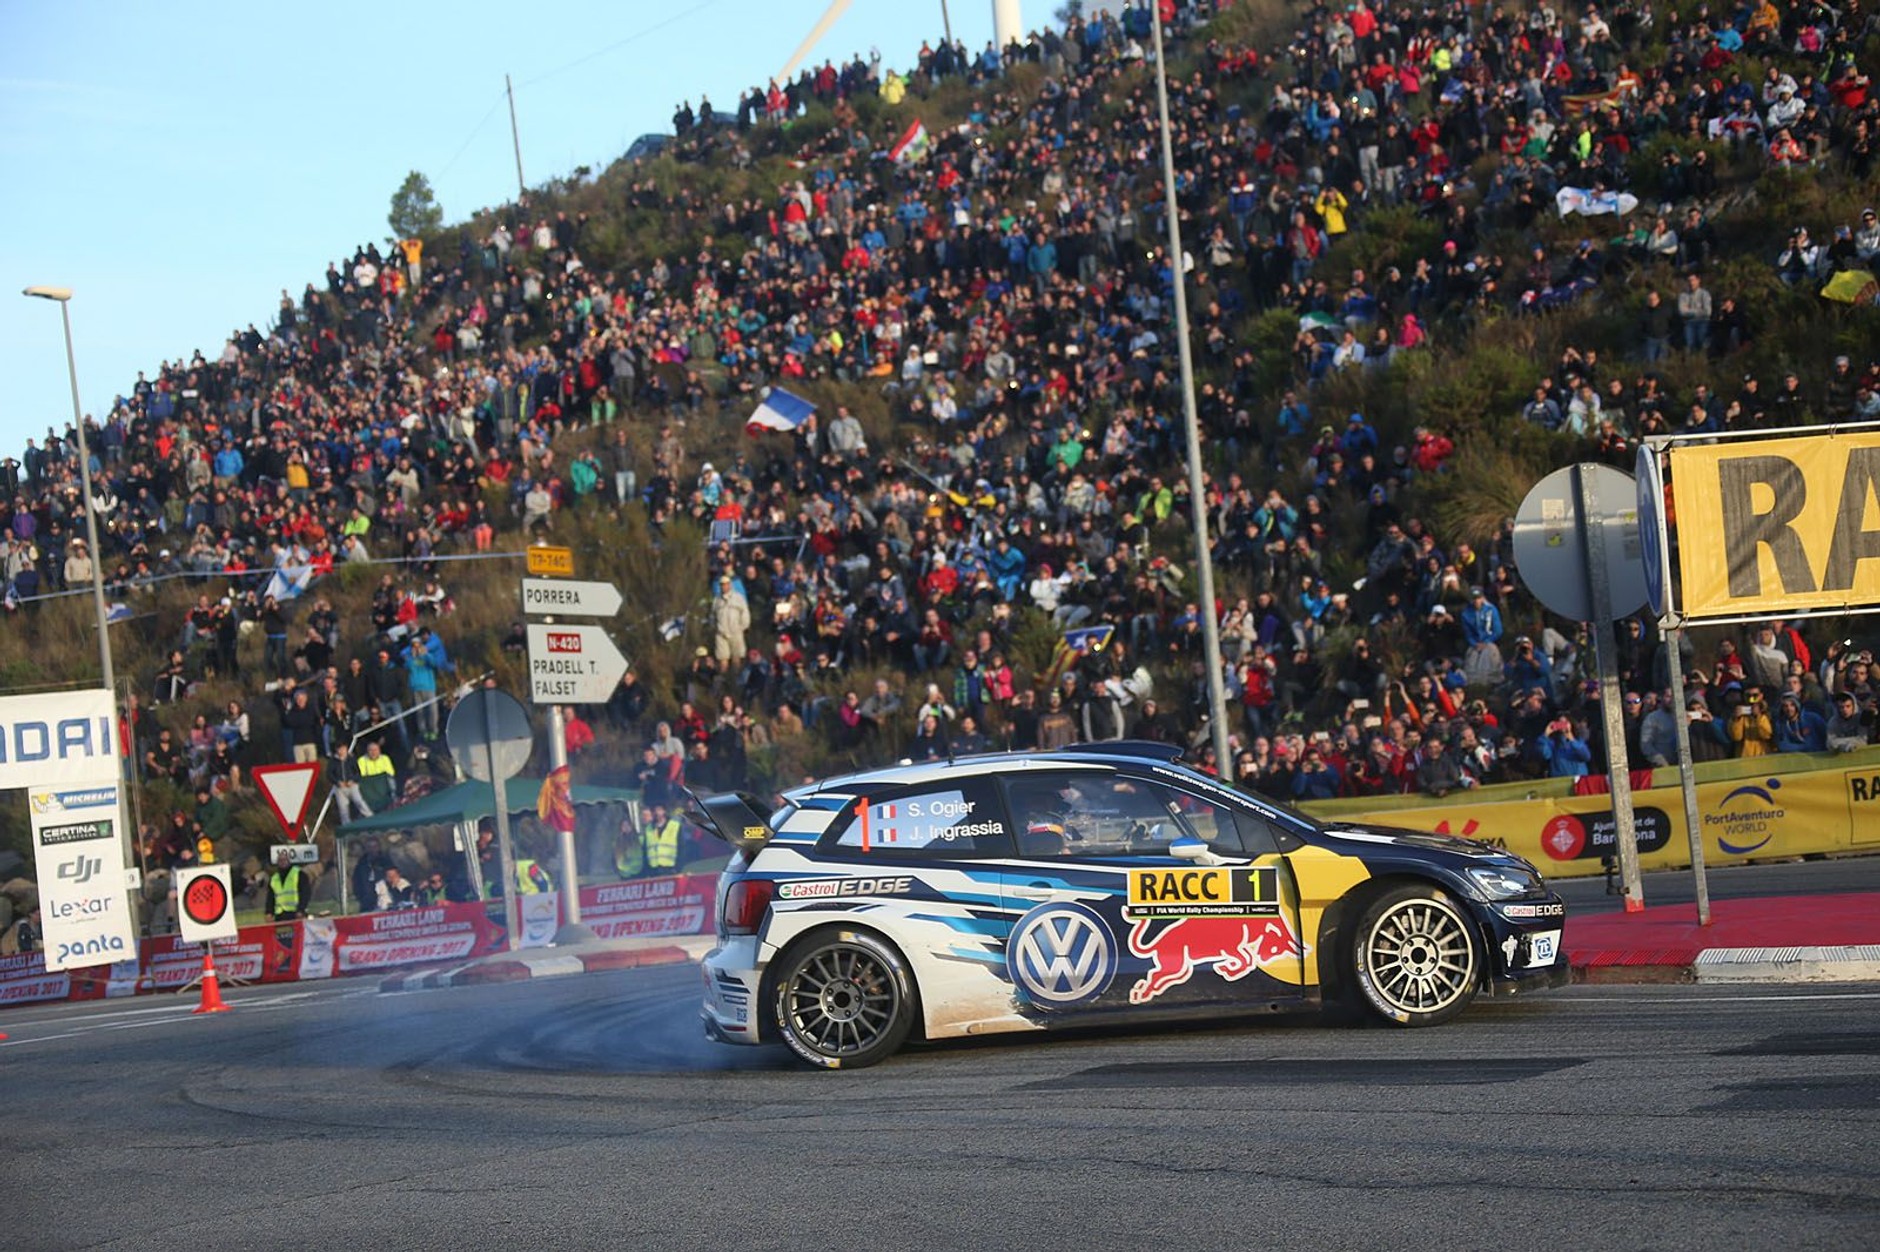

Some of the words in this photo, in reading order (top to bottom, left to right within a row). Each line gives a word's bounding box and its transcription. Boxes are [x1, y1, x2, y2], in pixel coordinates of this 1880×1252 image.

[1718, 446, 1880, 598] RA
[526, 588, 581, 604] PORRERA
[549, 637, 579, 649] N-420
[533, 659, 583, 674] PRADELL
[535, 681, 576, 695] FALSET
[0, 716, 111, 764] DAI
[908, 803, 925, 817] S.
[930, 800, 976, 818] Ogier
[1704, 808, 1785, 825] PortAventura
[42, 824, 97, 838] CERTINA
[853, 797, 870, 852] 1
[909, 826, 924, 840] J.
[929, 820, 1004, 841] Ingrassia
[1724, 822, 1767, 835] WORLD
[792, 883, 837, 897] Castrol
[839, 877, 914, 896] EDGE
[1140, 872, 1219, 900] RACC
[1248, 869, 1261, 901] 1
[50, 897, 112, 918] Lexar
[1536, 904, 1563, 916] EDGE
[57, 934, 124, 964] panta
